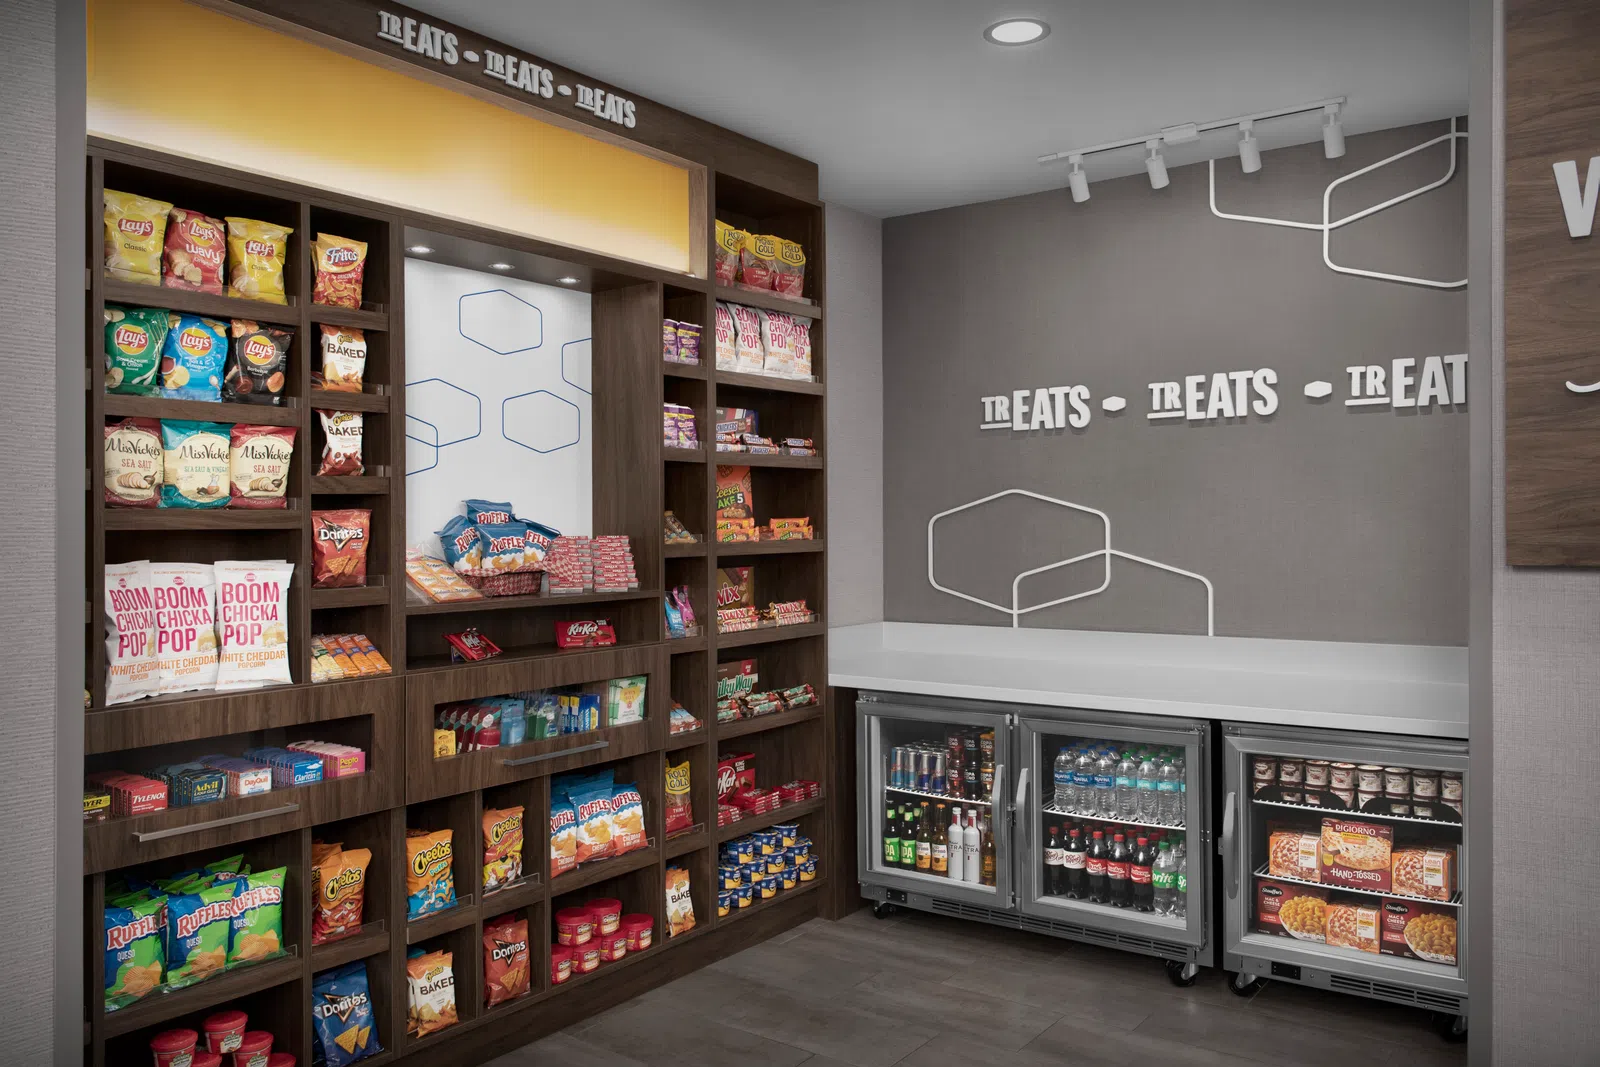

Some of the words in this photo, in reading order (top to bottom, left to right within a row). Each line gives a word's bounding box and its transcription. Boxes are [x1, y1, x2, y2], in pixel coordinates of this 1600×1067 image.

[377, 10, 458, 64] TREATS
[484, 50, 554, 98] TREATS
[575, 84, 636, 128] TREATS
[120, 219, 152, 234] Lay's
[118, 328, 148, 348] Lay's
[182, 334, 210, 350] Lay's
[246, 340, 275, 358] Lay's
[327, 343, 366, 359] BAKED
[980, 384, 1090, 431] TREATS
[1148, 368, 1278, 420] TREATS
[1345, 354, 1468, 408] TREAT
[716, 422, 738, 432] SNICKERS
[202, 442, 230, 464] Vickie
[121, 458, 136, 468] SEA
[138, 460, 152, 470] SALT
[254, 465, 266, 473] SEA
[268, 466, 282, 474] SALT
[718, 496, 736, 508] AKE
[737, 492, 744, 504] 5
[477, 512, 510, 524] RUFFLE
[320, 527, 364, 540] Doritos
[456, 527, 479, 554] RUFFLE
[525, 530, 551, 550] FFLES
[490, 536, 525, 553] RUFFLES
[110, 587, 152, 612] BOOM
[154, 586, 208, 610] BOOM
[222, 582, 280, 604] BOOM
[116, 610, 154, 632] CHICKA
[156, 608, 212, 629] CHICKA
[222, 604, 278, 622] CHICKA
[158, 628, 196, 654] POP
[224, 622, 262, 646] POP
[118, 632, 146, 658] POP
[238, 661, 266, 669] POPCORN
[246, 650, 286, 662] CHEDDAR
[137, 661, 158, 674] CHEDD
[174, 667, 200, 676] POPCORN
[717, 676, 736, 698] ilky
[735, 673, 752, 693] Way
[195, 781, 219, 792] Advil
[244, 776, 268, 786] DayQuil
[84, 799, 103, 807] AYER
[133, 792, 166, 804] TYLENOL
[491, 816, 520, 844] Cheetos
[550, 810, 574, 832] RUFFLE
[1335, 824, 1376, 836] DIGIORNO
[412, 840, 452, 877] Cheetos
[1152, 872, 1174, 884] prite
[1330, 868, 1382, 882] HAND-TOSSED
[324, 868, 362, 902] Cheetos
[230, 886, 282, 916] RUFFLES
[670, 890, 690, 904] BAKE
[177, 901, 232, 938] RUFFLES
[107, 914, 158, 950] RUFFLE
[186, 936, 202, 948] QUESO
[493, 940, 526, 960] Doritos
[117, 950, 136, 960] QUESO
[420, 976, 455, 996] BAKED
[322, 992, 368, 1018] Doritos
